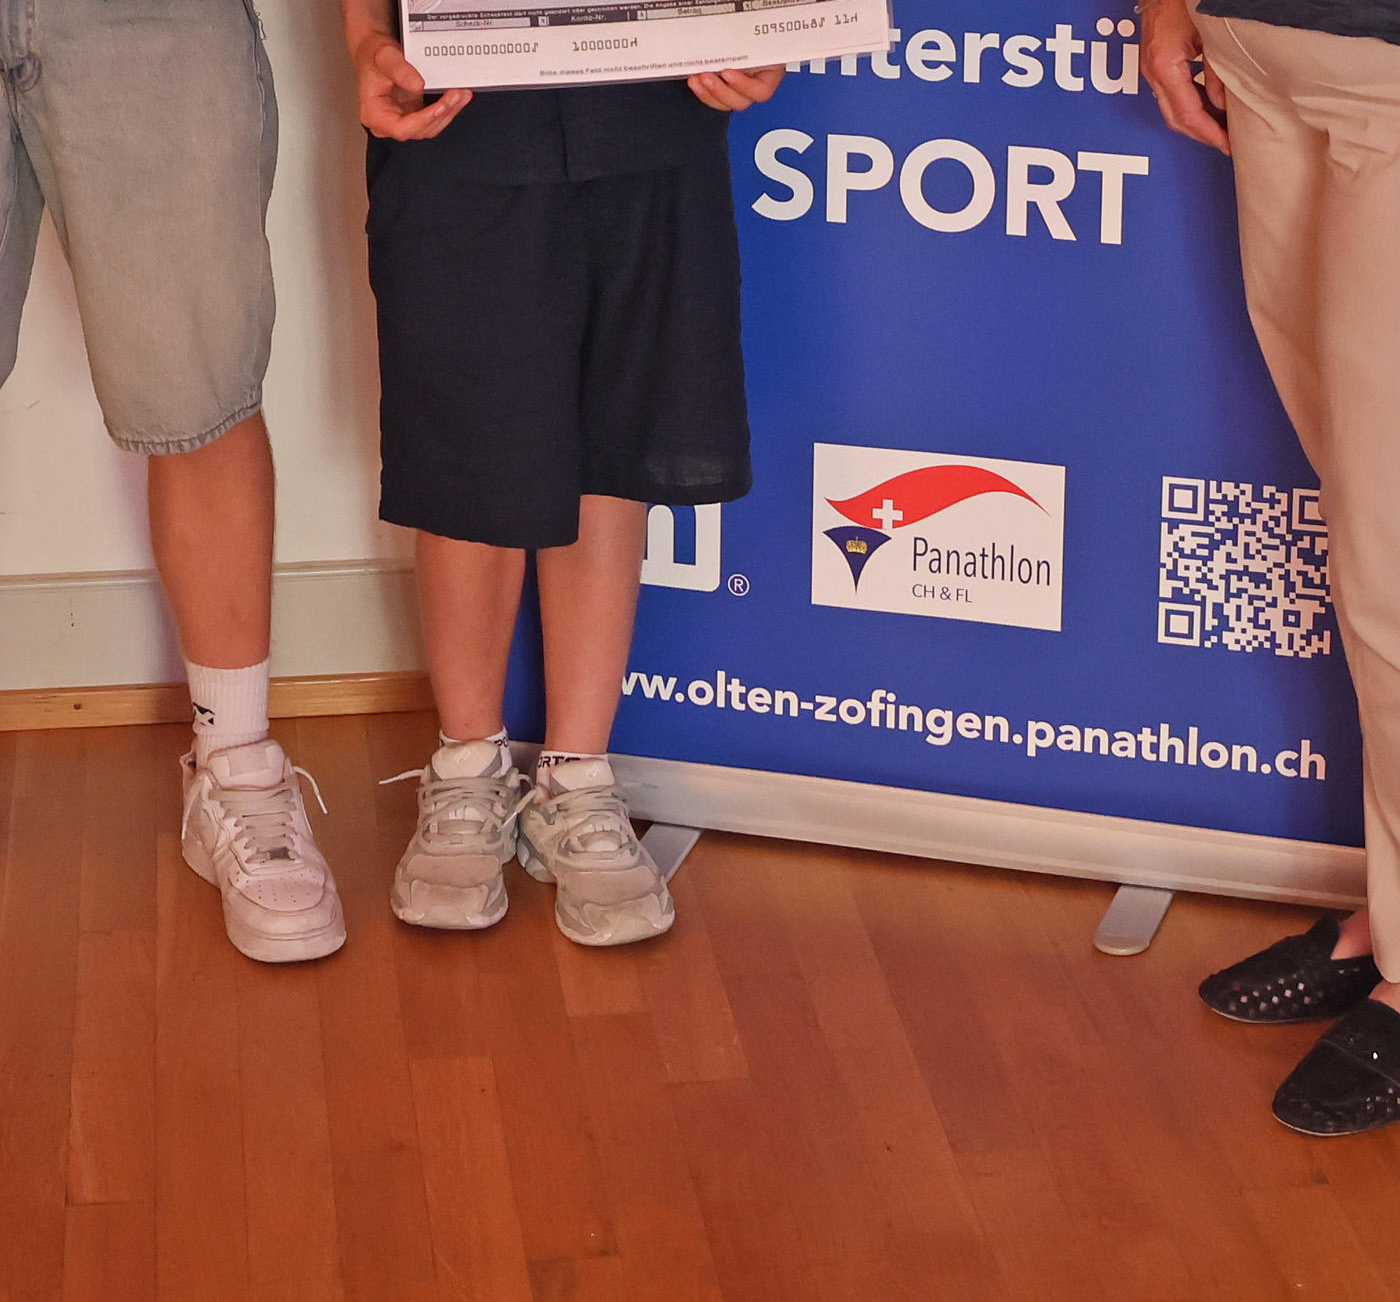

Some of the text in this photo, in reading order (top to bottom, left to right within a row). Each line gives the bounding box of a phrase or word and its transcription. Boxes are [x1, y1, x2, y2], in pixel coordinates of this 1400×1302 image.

[786, 16, 1141, 95] terstü
[750, 128, 1150, 245] SPORT
[912, 536, 1051, 587] Panathlon
[912, 583, 973, 604] CH & FL
[621, 670, 1327, 781] w.olten-zofingen.panathlon.ch
